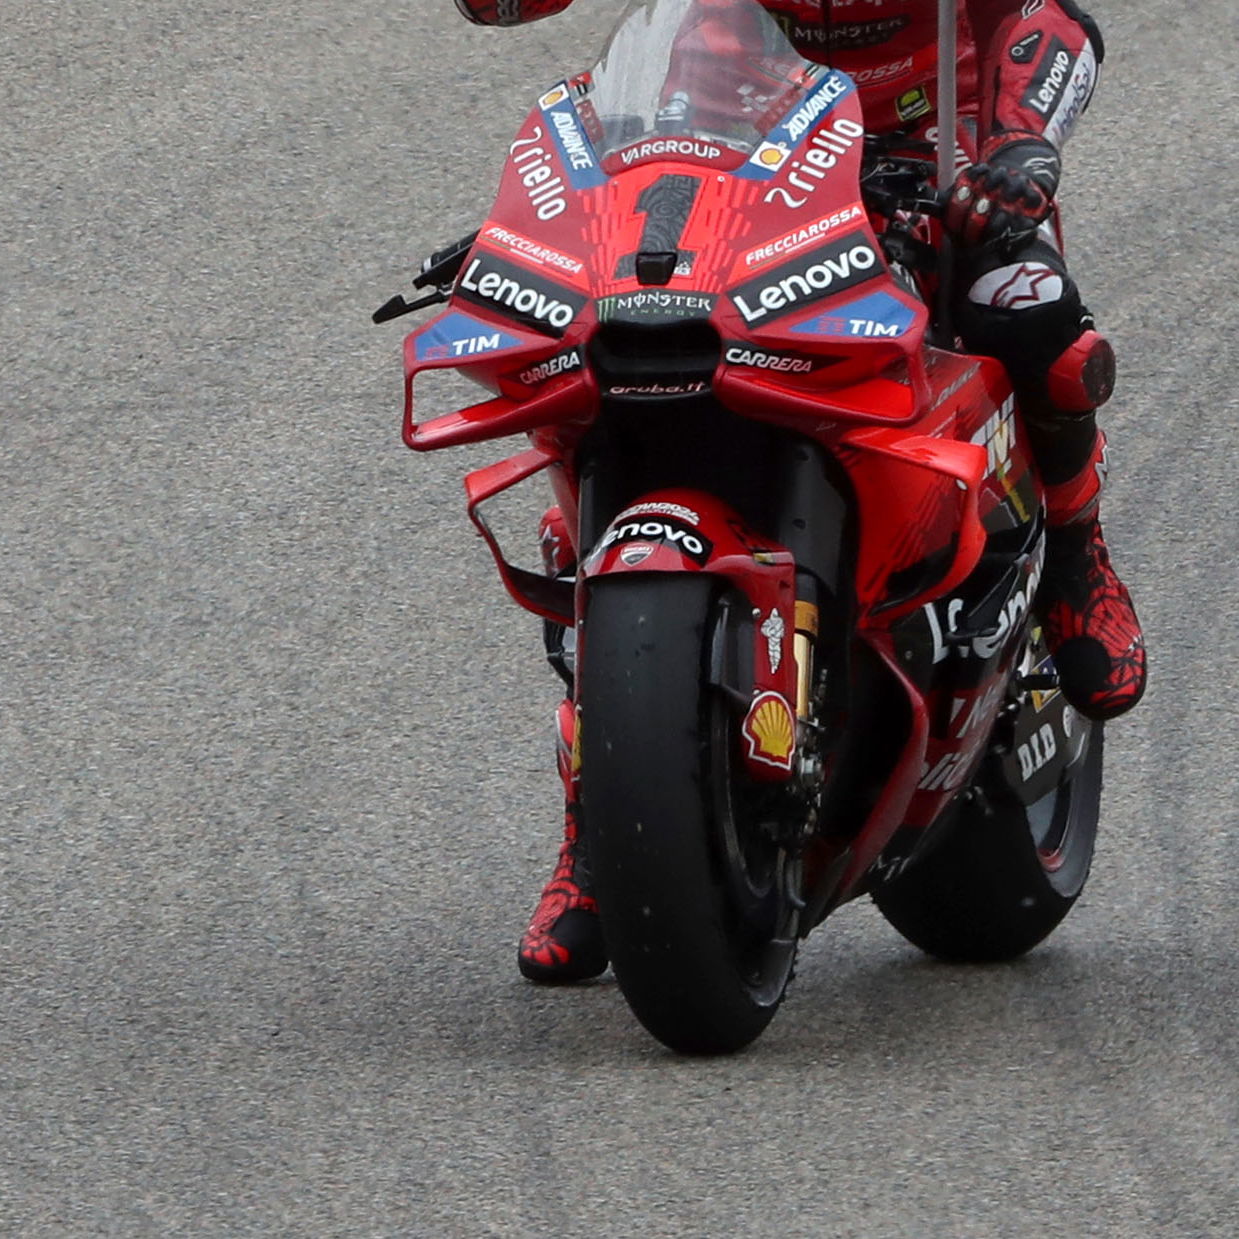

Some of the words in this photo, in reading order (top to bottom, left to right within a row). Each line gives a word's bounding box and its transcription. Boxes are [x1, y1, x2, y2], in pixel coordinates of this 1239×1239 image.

[783, 75, 847, 141] ADVANCE
[1028, 50, 1070, 113] Lenovo
[550, 111, 594, 171] ADVANCE
[788, 118, 864, 193] riello
[513, 146, 567, 222] riello
[485, 226, 584, 274] FRECCIAROSSA
[613, 173, 704, 279] 1
[745, 205, 863, 266] FRECCIAROSSA
[461, 259, 574, 328] Lenovo
[733, 245, 876, 323] Lenovo
[452, 333, 502, 356] TIM
[848, 318, 900, 337] TIM
[519, 351, 581, 385] CARRERA
[610, 381, 705, 395] aruba.it
[725, 347, 813, 373] CARRERA
